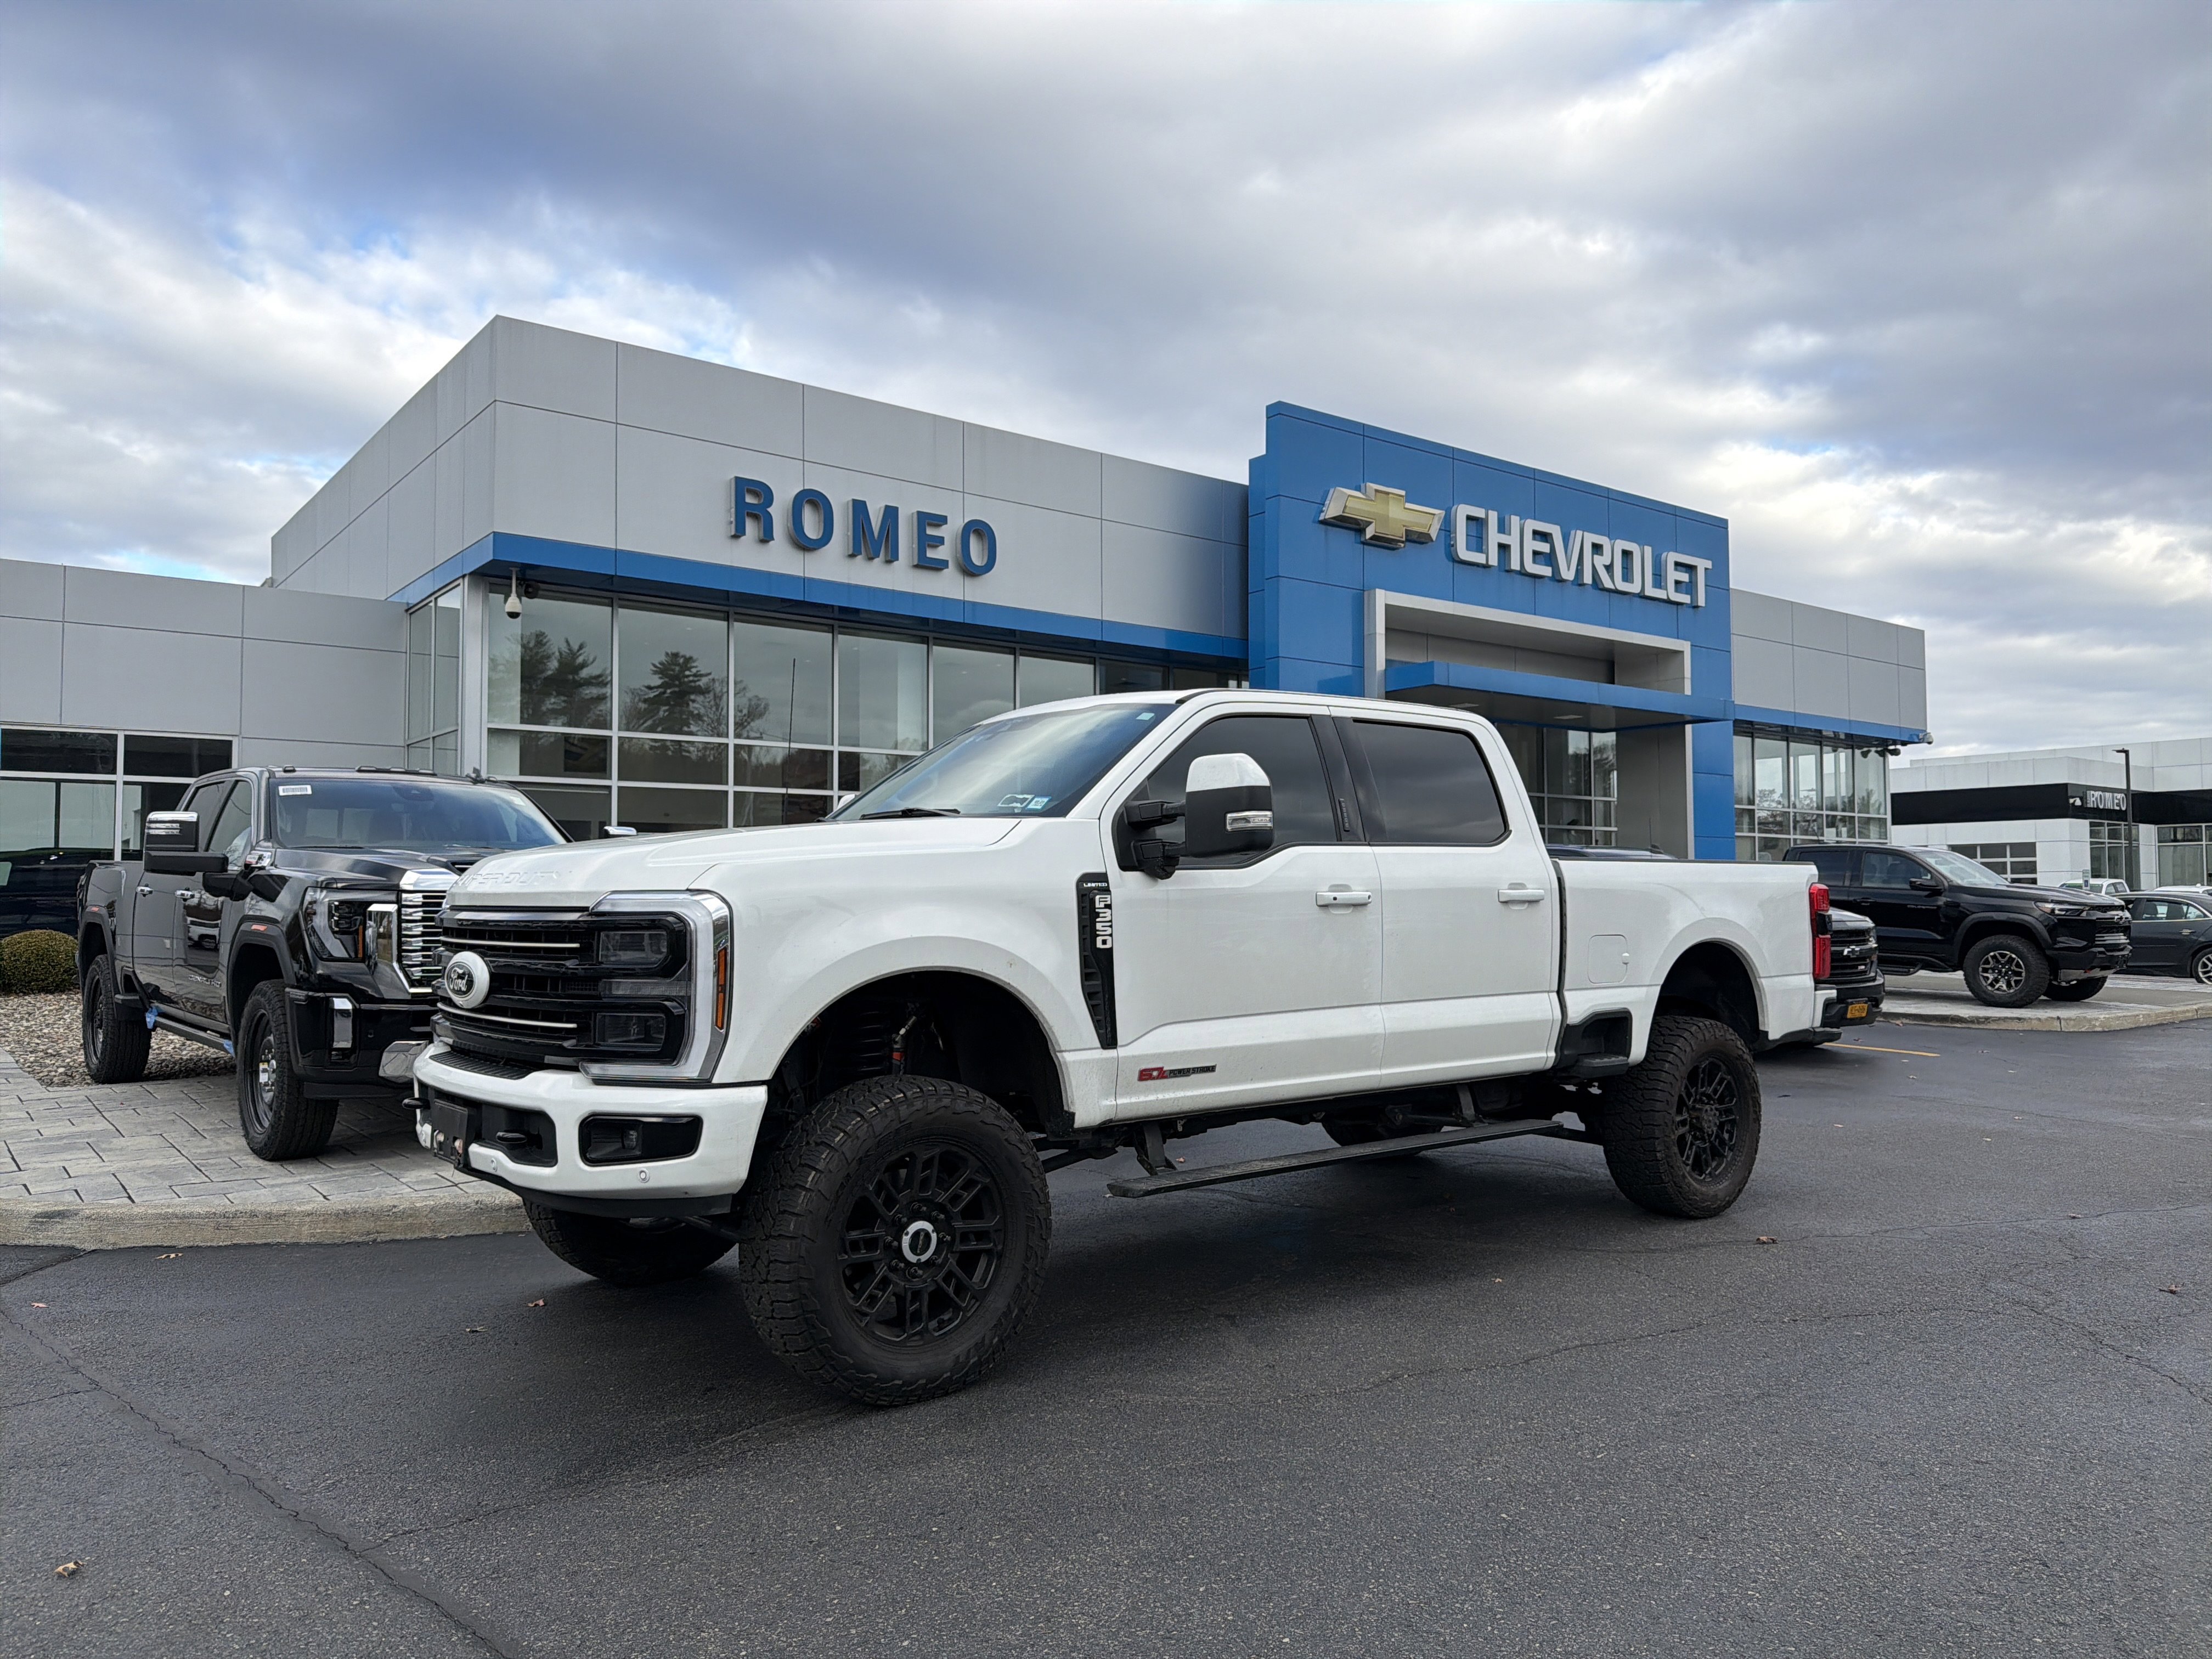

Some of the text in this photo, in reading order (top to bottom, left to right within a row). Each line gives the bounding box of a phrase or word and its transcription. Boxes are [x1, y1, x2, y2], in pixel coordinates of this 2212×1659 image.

[730, 476, 997, 577] ROMEO
[1451, 504, 1712, 607] CHEVROLET
[2087, 791, 2126, 811] ROMEO
[450, 967, 469, 991] Ford
